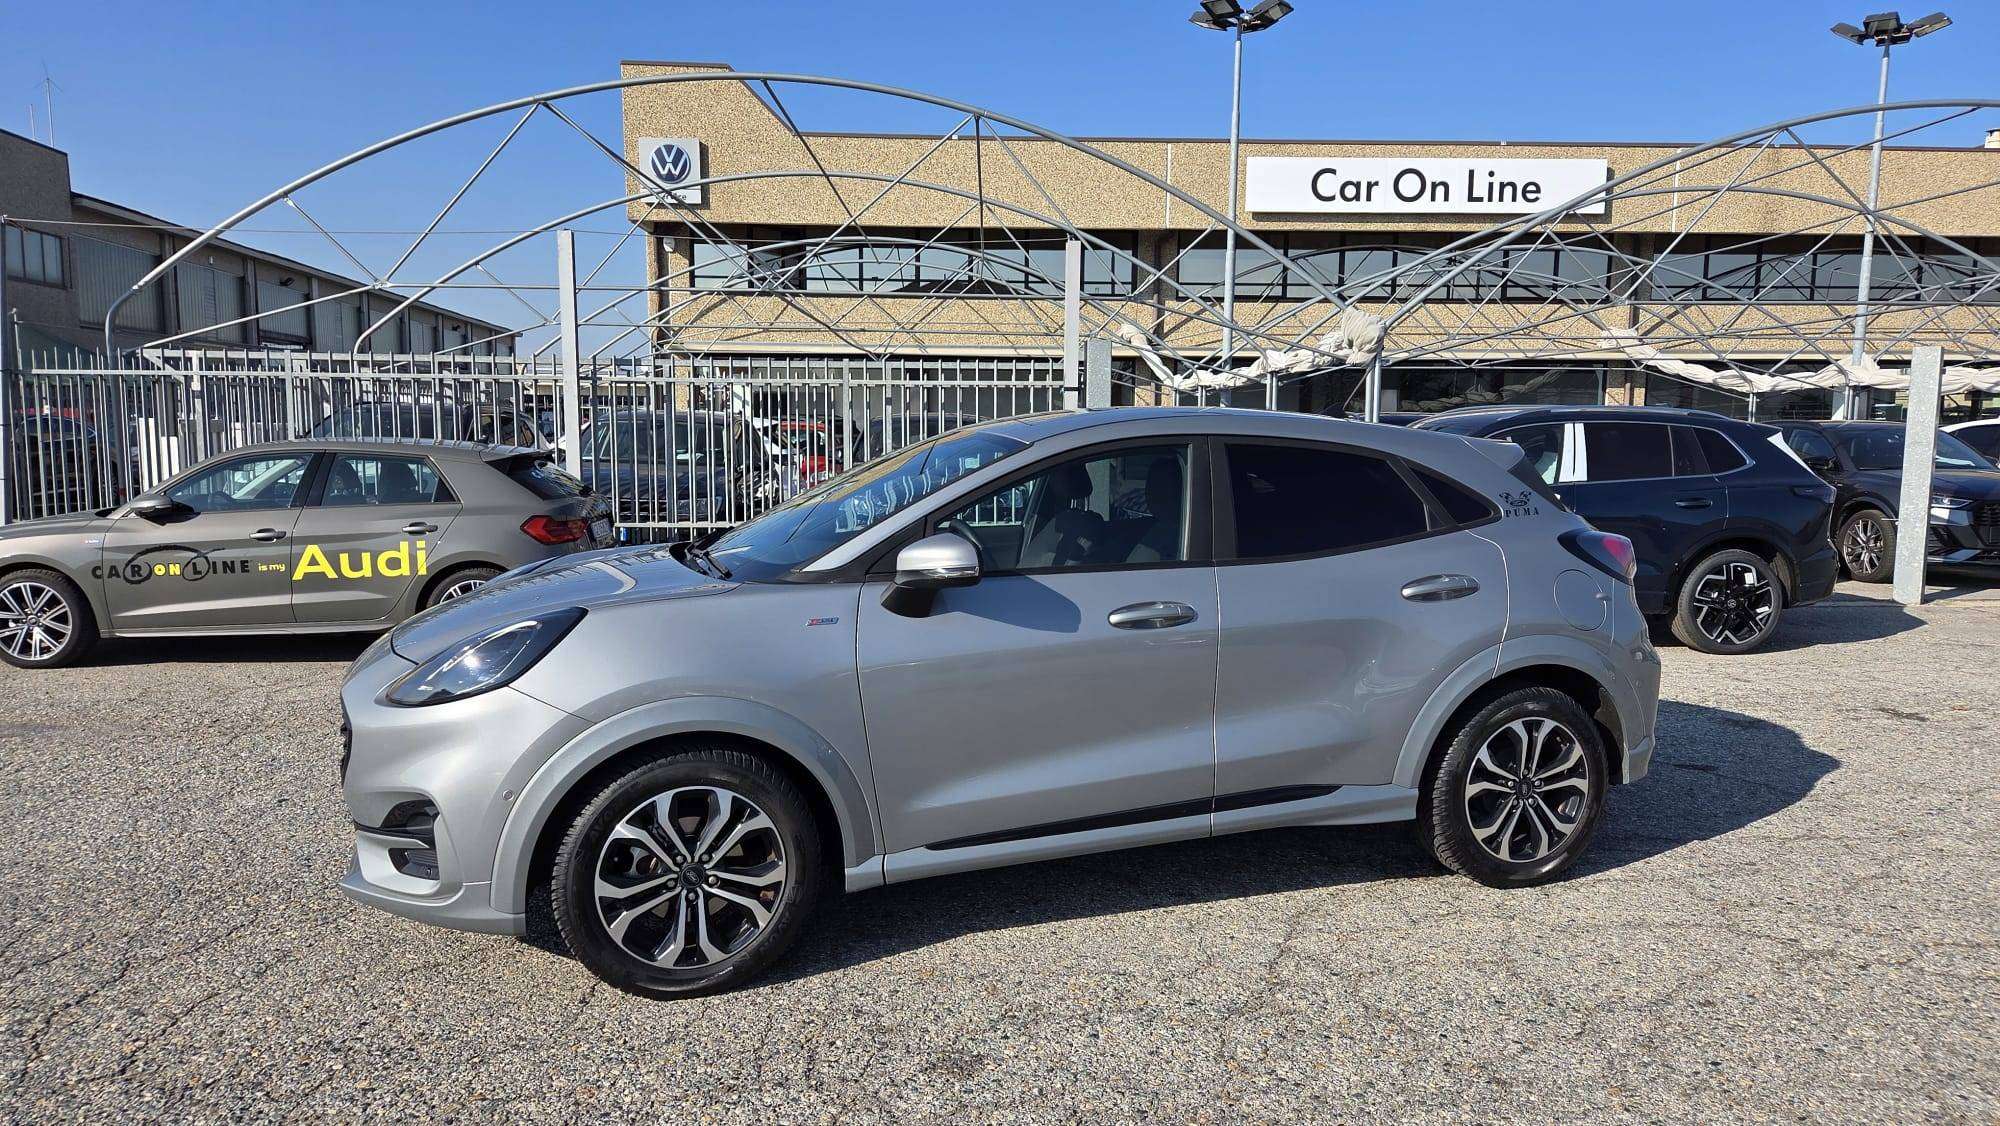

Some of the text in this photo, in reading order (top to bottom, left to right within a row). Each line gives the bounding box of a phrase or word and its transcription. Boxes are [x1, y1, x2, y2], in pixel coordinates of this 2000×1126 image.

[1311, 167, 1541, 203] Car On Line
[1505, 507, 1539, 518] PUMA
[91, 540, 427, 580] CAR ON LINE is my Audi
